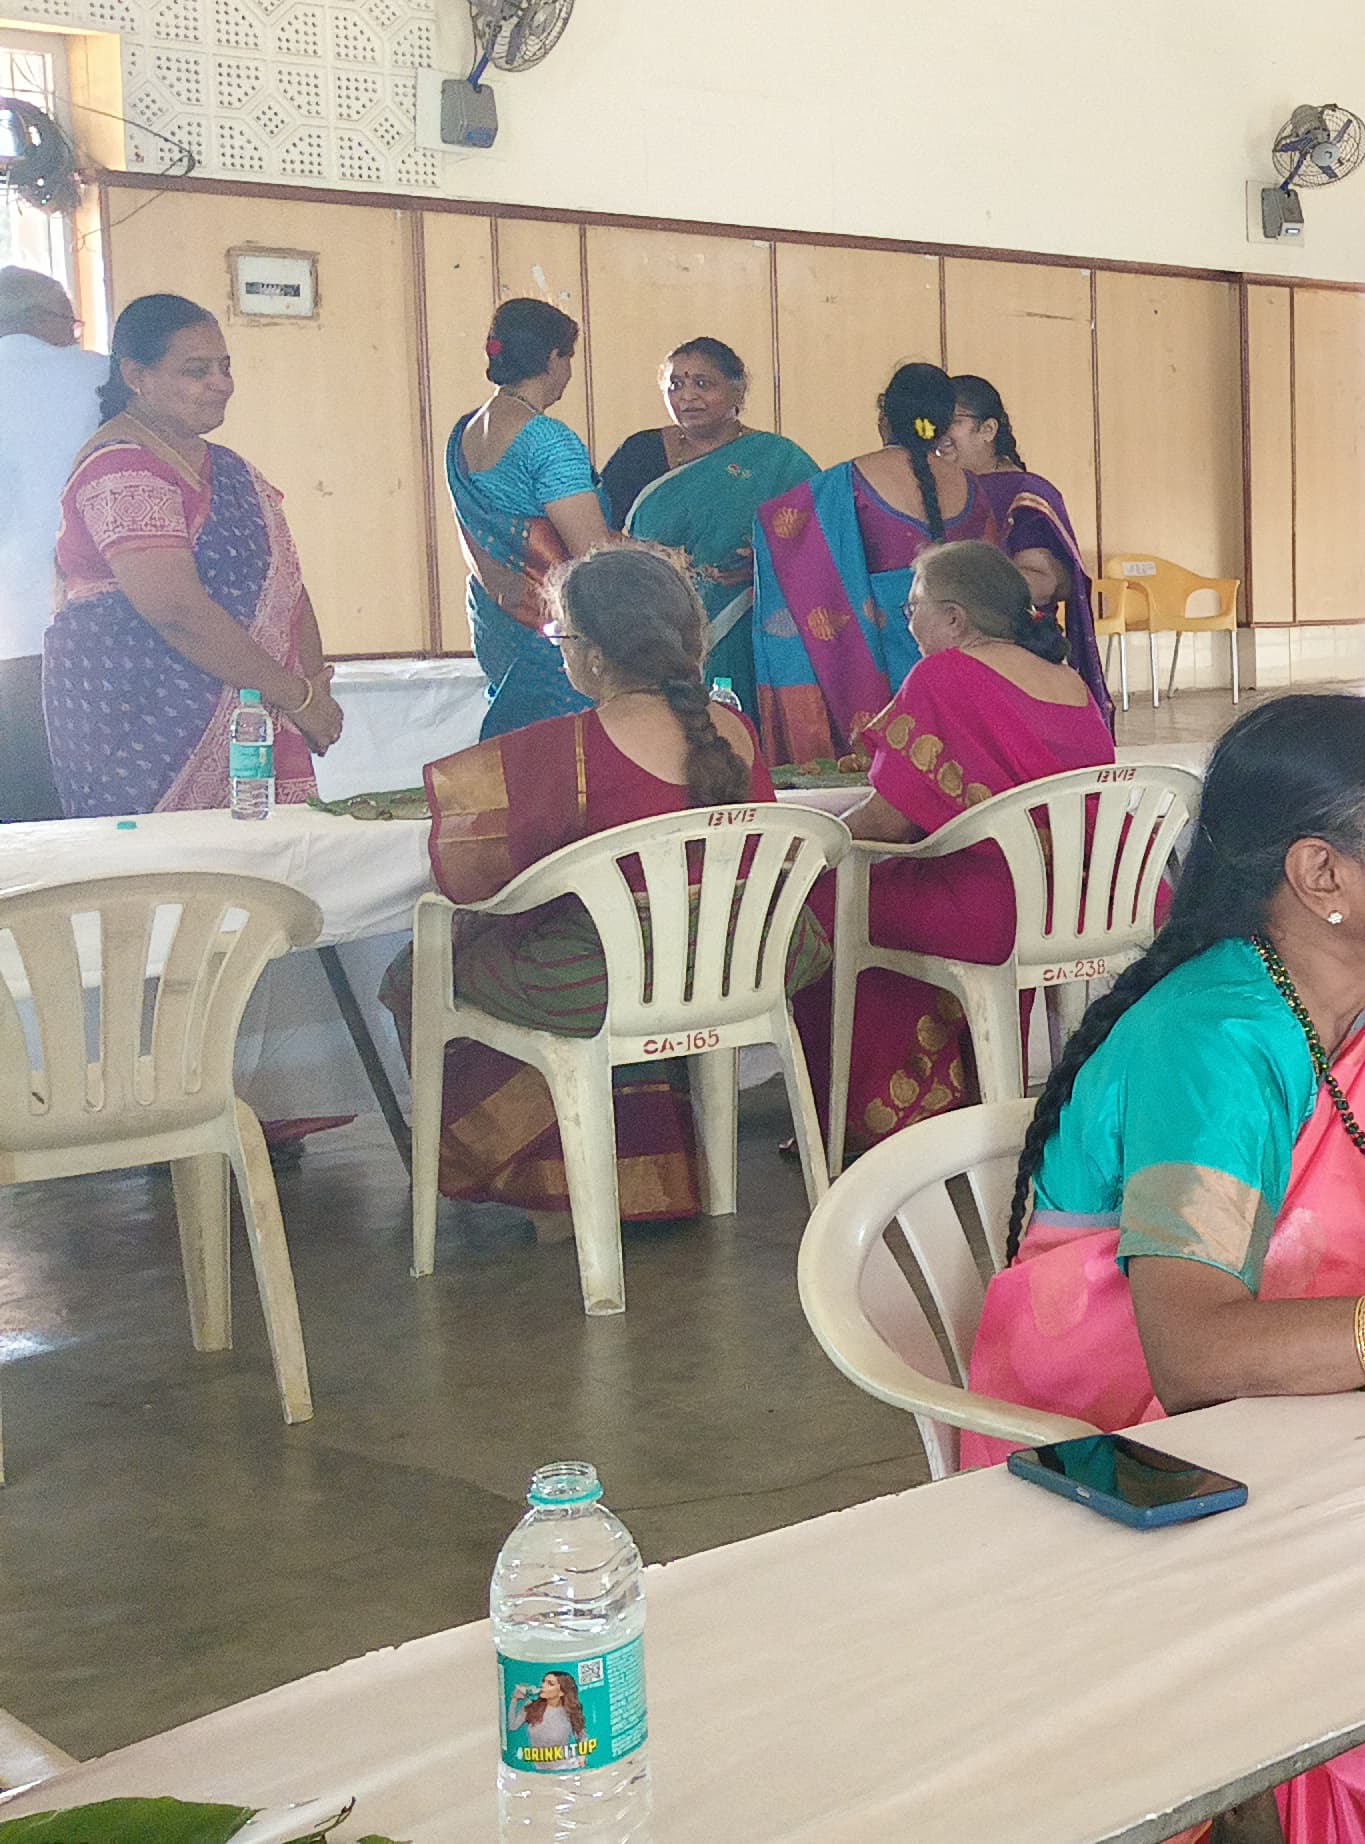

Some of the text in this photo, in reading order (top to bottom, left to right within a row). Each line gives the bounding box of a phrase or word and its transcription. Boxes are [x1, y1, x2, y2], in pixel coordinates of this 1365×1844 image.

[1096, 767, 1137, 783] BVB
[707, 807, 758, 827] BVB
[643, 1028, 720, 1055] CA-165
